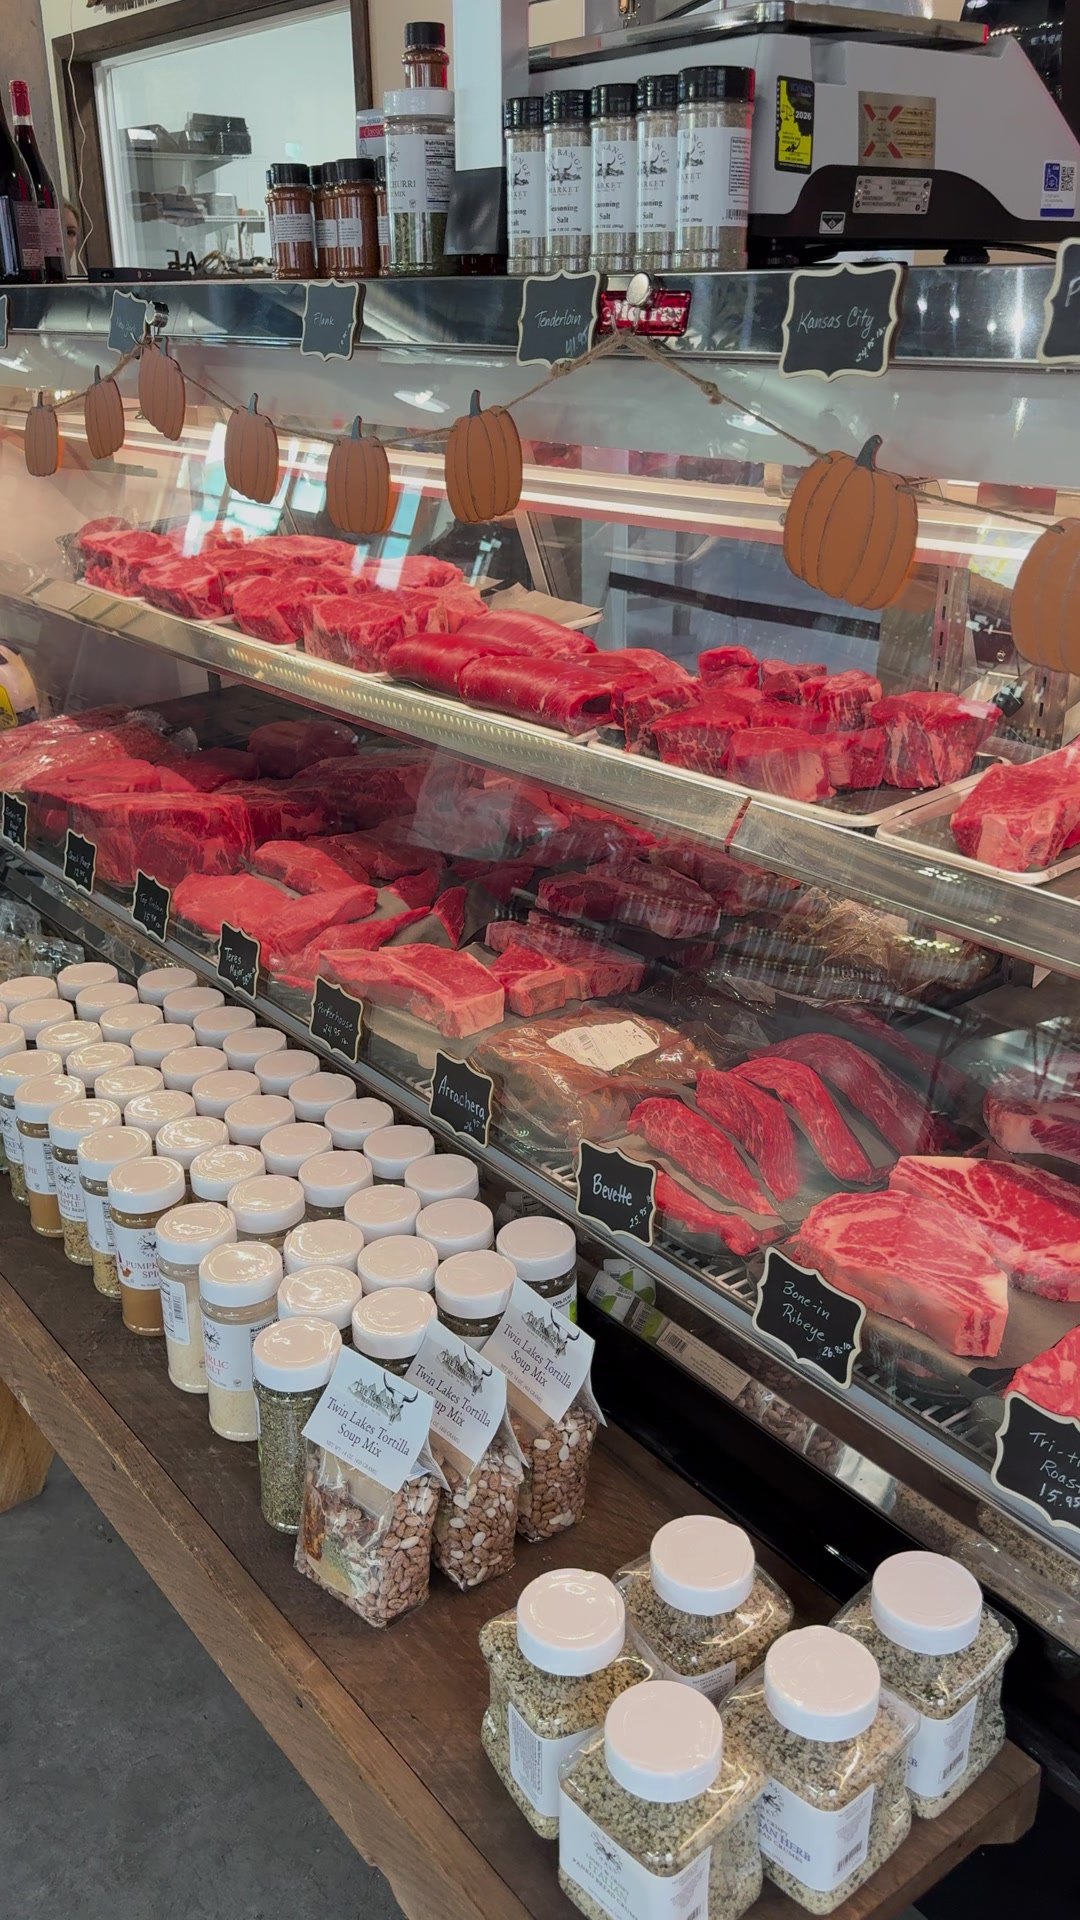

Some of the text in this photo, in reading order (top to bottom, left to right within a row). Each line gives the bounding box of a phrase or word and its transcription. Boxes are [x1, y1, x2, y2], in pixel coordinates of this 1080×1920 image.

[312, 312, 335, 326] Flank
[534, 309, 582, 329] Tenderloin
[797, 306, 874, 339] Kansas City
[317, 1001, 354, 1032] Porterhouse
[438, 1074, 485, 1121] Arrachera
[593, 1173, 633, 1207] Bevette
[125, 1259, 158, 1270] PUMPK
[142, 1270, 160, 1279] SPI
[782, 1280, 831, 1320] Bone-in
[782, 1302, 826, 1342] Ribeye
[503, 1323, 573, 1389] Twin Lakes Tortilla
[511, 1350, 548, 1387] Soup Mix
[415, 1364, 491, 1427] Twin Lakes Tortilla
[327, 1397, 410, 1455] Twin Lakes Tortilla
[447, 1406, 465, 1427] Mix
[338, 1423, 382, 1457] Soup Mix
[778, 1834, 813, 1862] HERB
